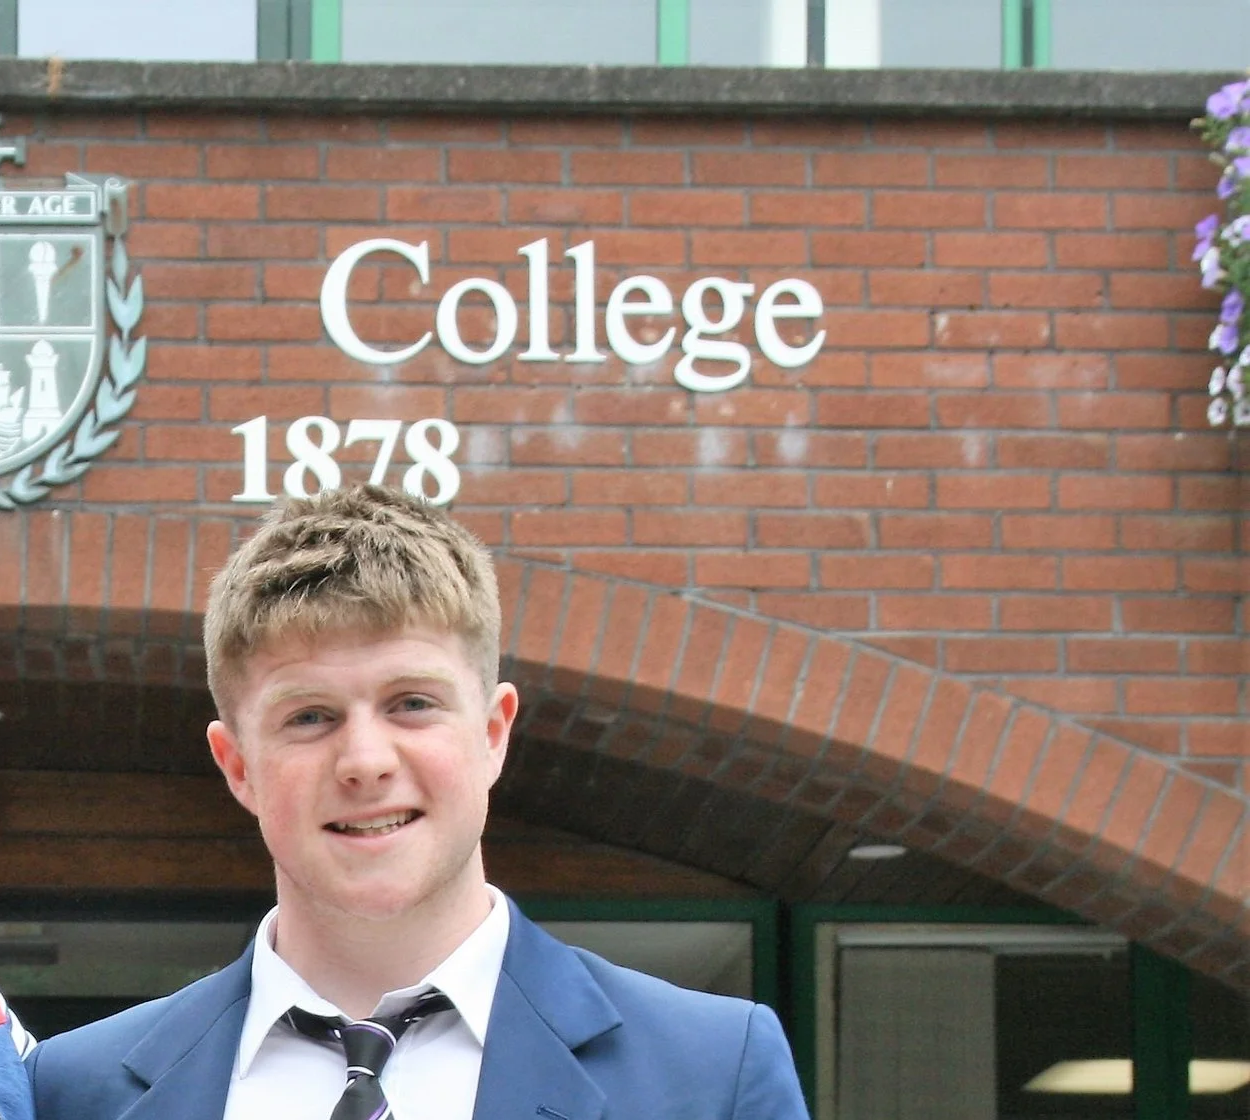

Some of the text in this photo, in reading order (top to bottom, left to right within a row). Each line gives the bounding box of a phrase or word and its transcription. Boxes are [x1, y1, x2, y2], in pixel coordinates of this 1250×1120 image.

[27, 194, 76, 215] AGE
[319, 237, 826, 392] College
[230, 415, 461, 507] 1878
